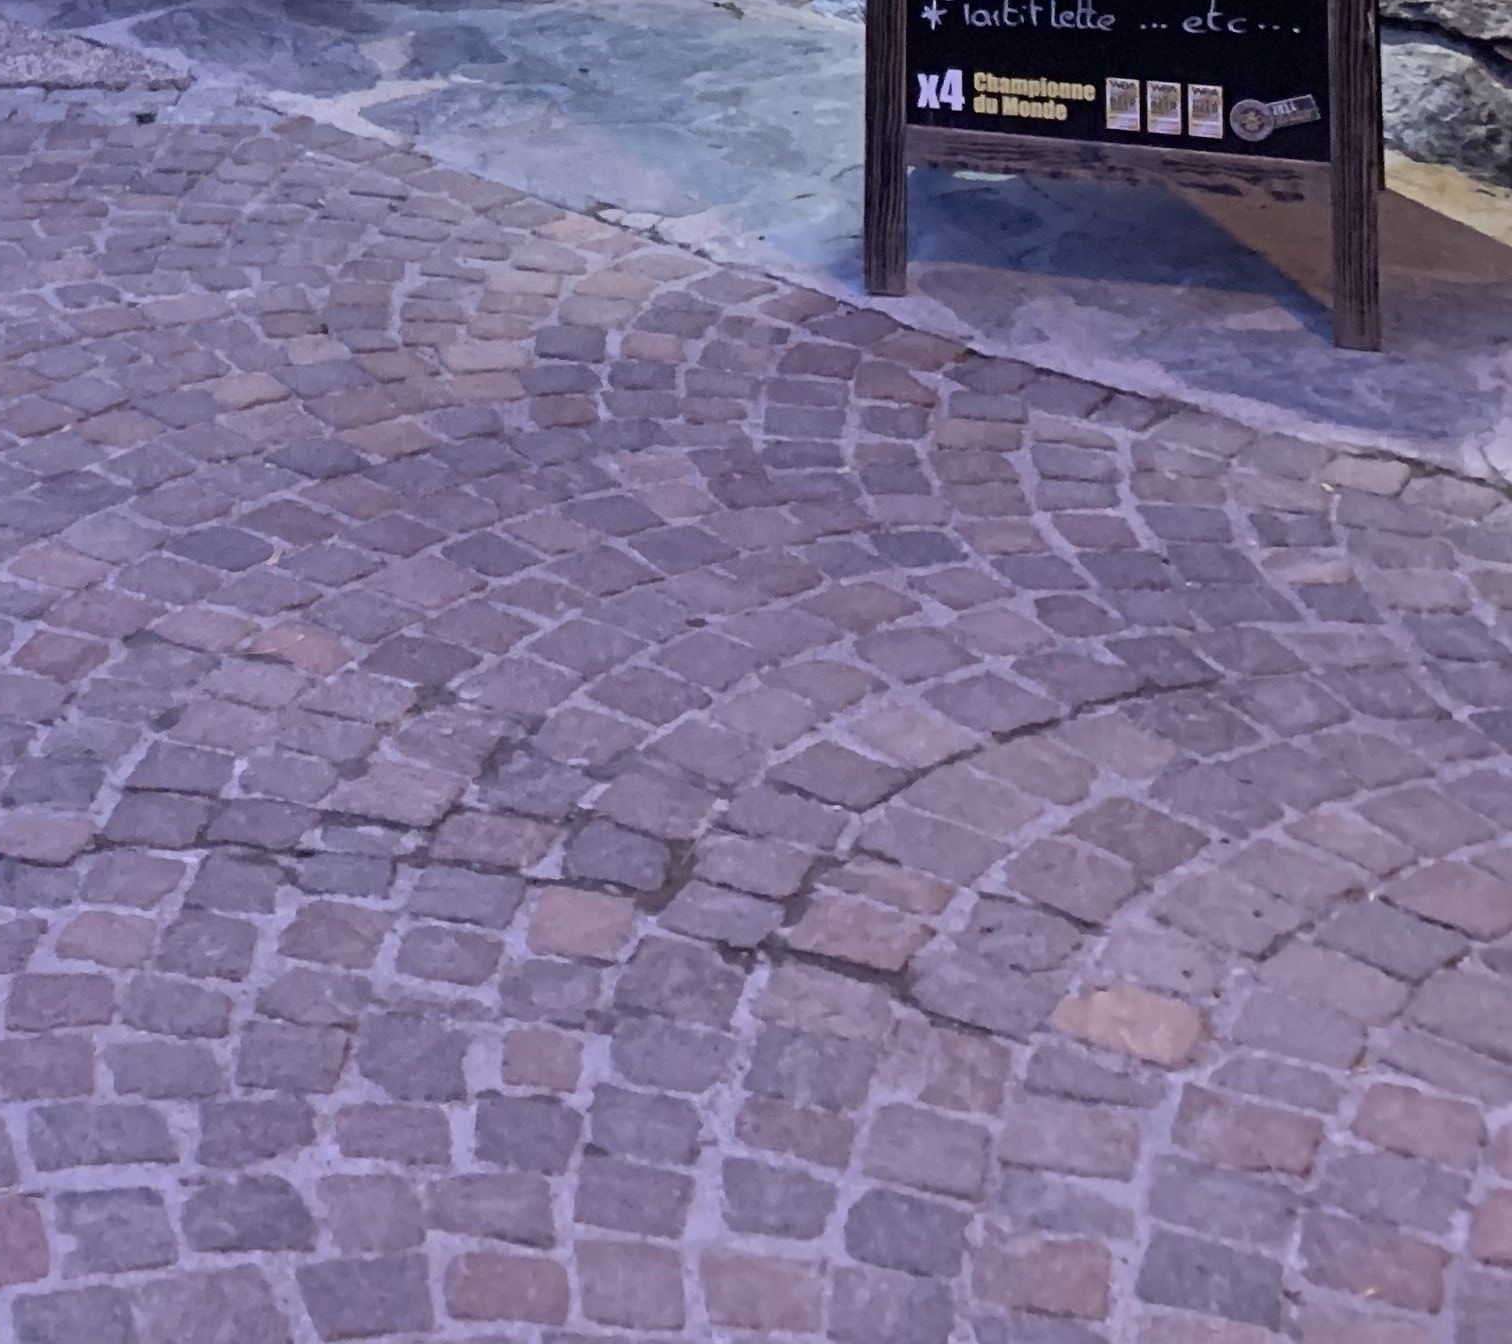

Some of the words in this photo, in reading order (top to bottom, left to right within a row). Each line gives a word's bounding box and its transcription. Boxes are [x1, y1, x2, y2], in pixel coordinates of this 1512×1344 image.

[973, 72, 1096, 102] Championne
[973, 95, 999, 115] du
[1001, 95, 1068, 121] Monde
